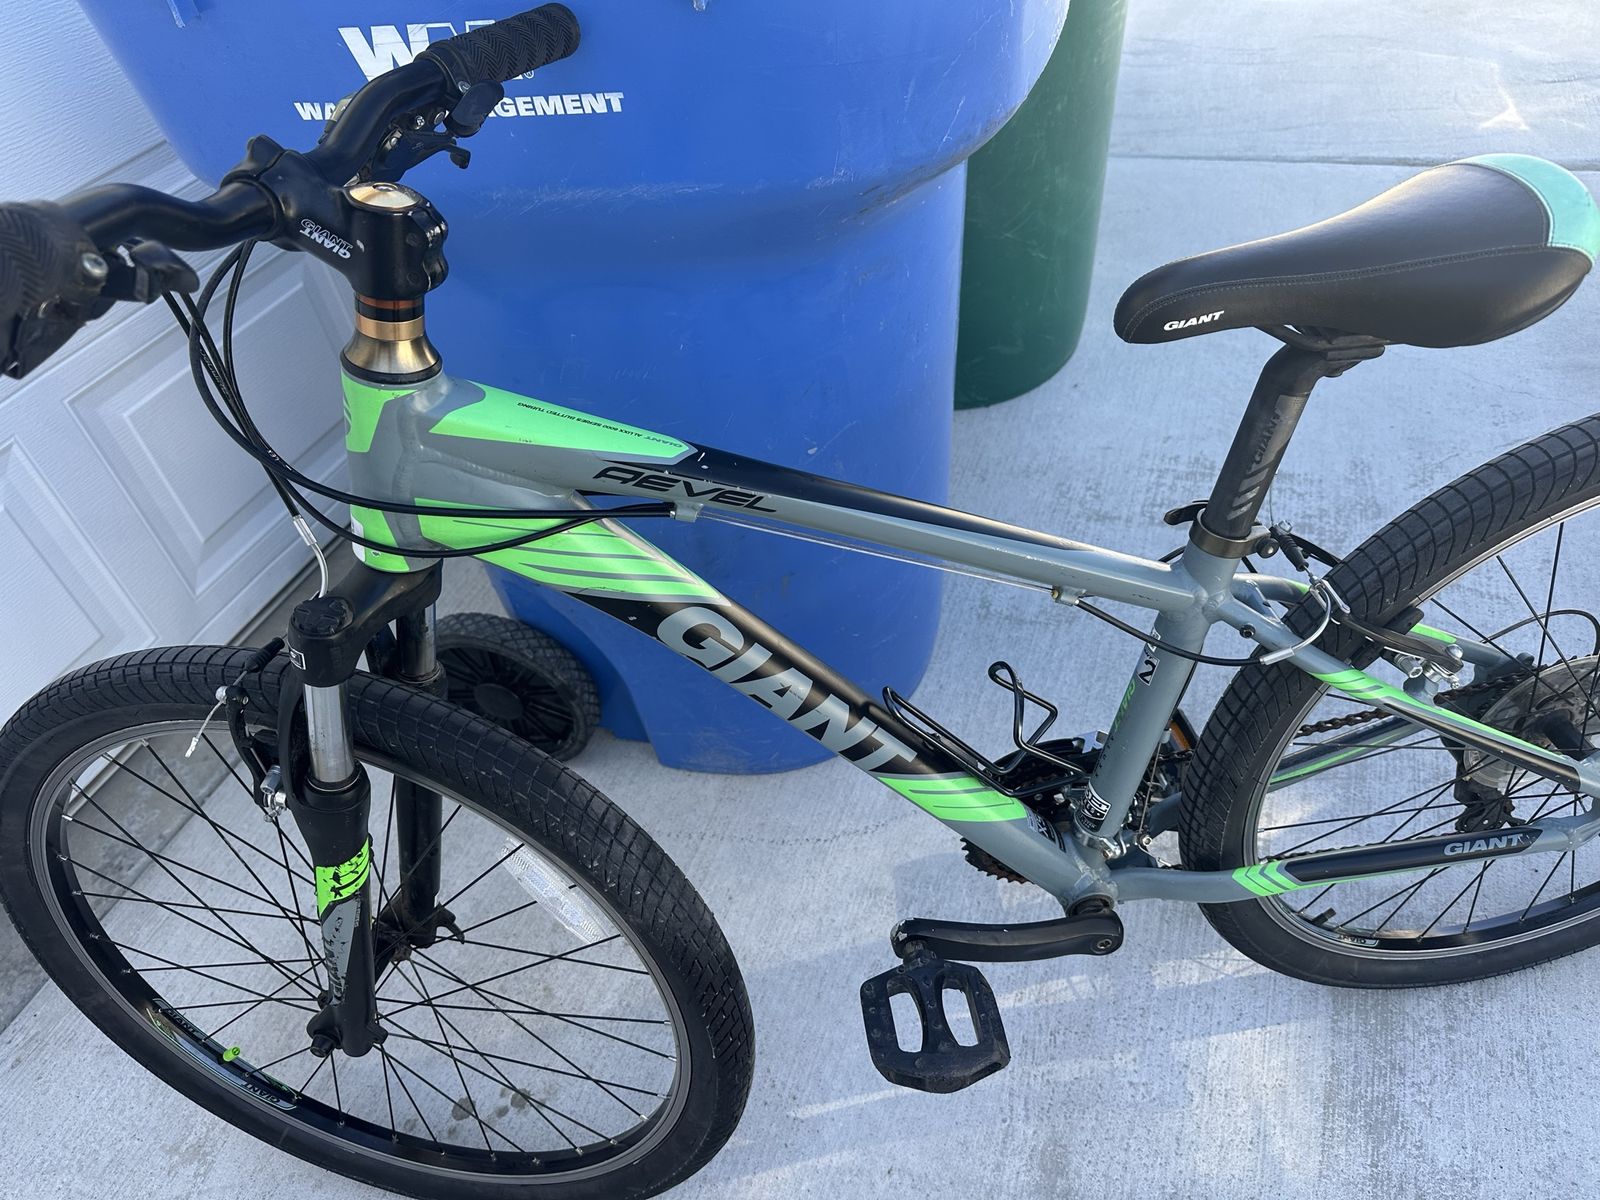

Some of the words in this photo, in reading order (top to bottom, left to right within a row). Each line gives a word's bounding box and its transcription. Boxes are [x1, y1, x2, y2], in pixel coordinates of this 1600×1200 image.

[338, 20, 523, 81] W
[488, 92, 624, 118] GEMENT
[300, 218, 353, 252] GIANT
[1163, 309, 1225, 331] GIANT
[592, 466, 777, 513] REVEL
[656, 606, 918, 772] GIANT
[1443, 833, 1524, 856] GIANT
